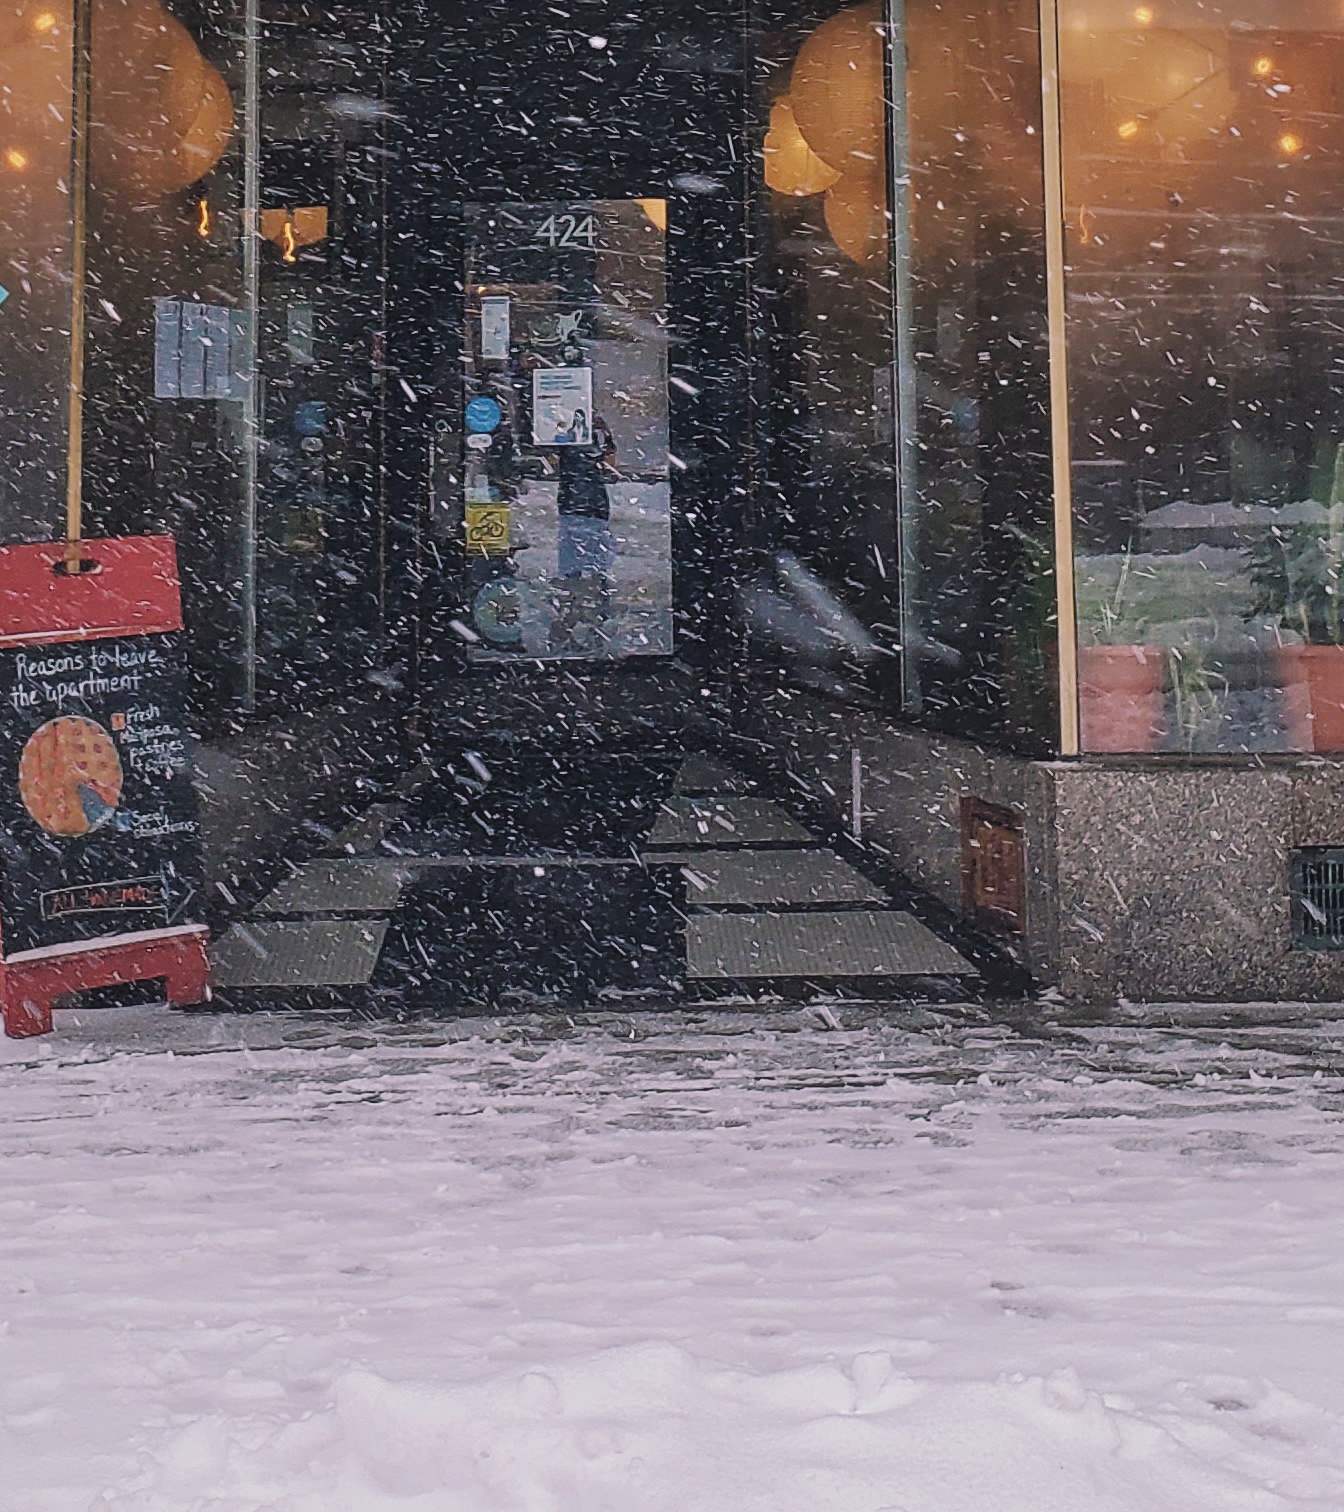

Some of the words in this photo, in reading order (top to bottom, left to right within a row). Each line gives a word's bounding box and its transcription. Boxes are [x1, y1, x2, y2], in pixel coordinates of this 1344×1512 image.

[534, 214, 598, 248] 424
[15, 652, 85, 681] Reasons
[89, 645, 107, 669] to
[113, 644, 167, 669] leave
[10, 683, 41, 708] the
[44, 669, 143, 710] apartment
